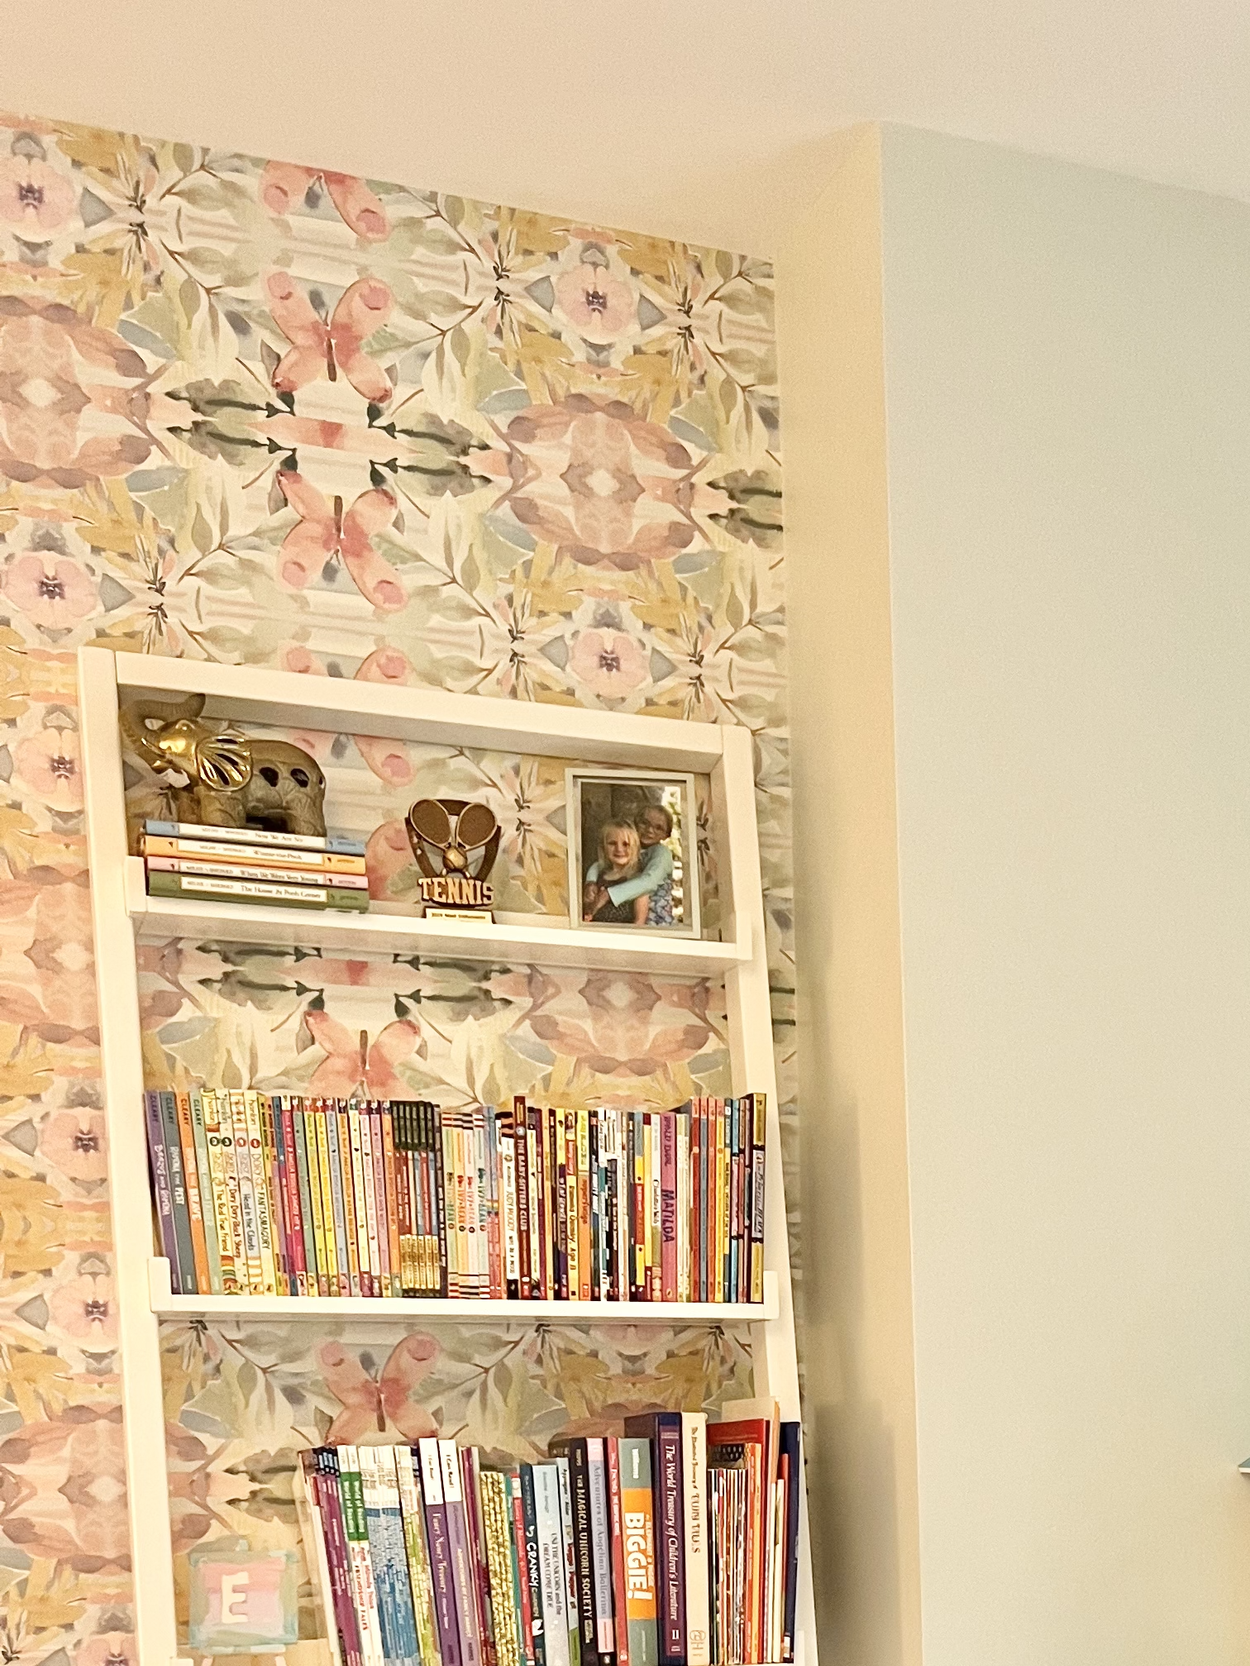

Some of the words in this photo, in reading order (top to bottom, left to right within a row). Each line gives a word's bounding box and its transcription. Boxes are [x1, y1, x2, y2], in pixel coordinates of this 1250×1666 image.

[418, 877, 494, 905] TENNIS
[150, 1095, 158, 1122] CLEARY
[181, 1098, 189, 1125] CLEARY
[193, 1099, 202, 1126] CLEARY
[166, 1097, 174, 1124] CLEARY
[175, 1187, 184, 1205] PEST
[517, 1140, 525, 1154] THE
[518, 1155, 527, 1209] BABY-SITTERS
[257, 1192, 270, 1250] FANTASMAGORY
[520, 1210, 528, 1231] CLUB
[661, 1189, 675, 1242] MATILDA
[665, 1444, 676, 1461] The
[593, 1465, 604, 1515] Adventures
[666, 1463, 677, 1488] World
[576, 1489, 587, 1531] MAGICAL
[597, 1517, 604, 1526] of
[665, 1489, 676, 1526] Treasury
[596, 1529, 607, 1570] Angelina
[664, 1527, 678, 1536] of
[526, 1542, 539, 1587] CRANKY
[543, 1543, 551, 1568] DREAM
[579, 1532, 590, 1575] UNICORN
[624, 1512, 653, 1600] BIGGIE!
[667, 1538, 679, 1579] Children's
[553, 1561, 561, 1590] UNICORN
[599, 1573, 609, 1615] Ballerina
[222, 1571, 249, 1624] E
[582, 1578, 593, 1618] SOCIETY
[669, 1580, 680, 1620] Literature
[360, 1609, 369, 1631] TALES
